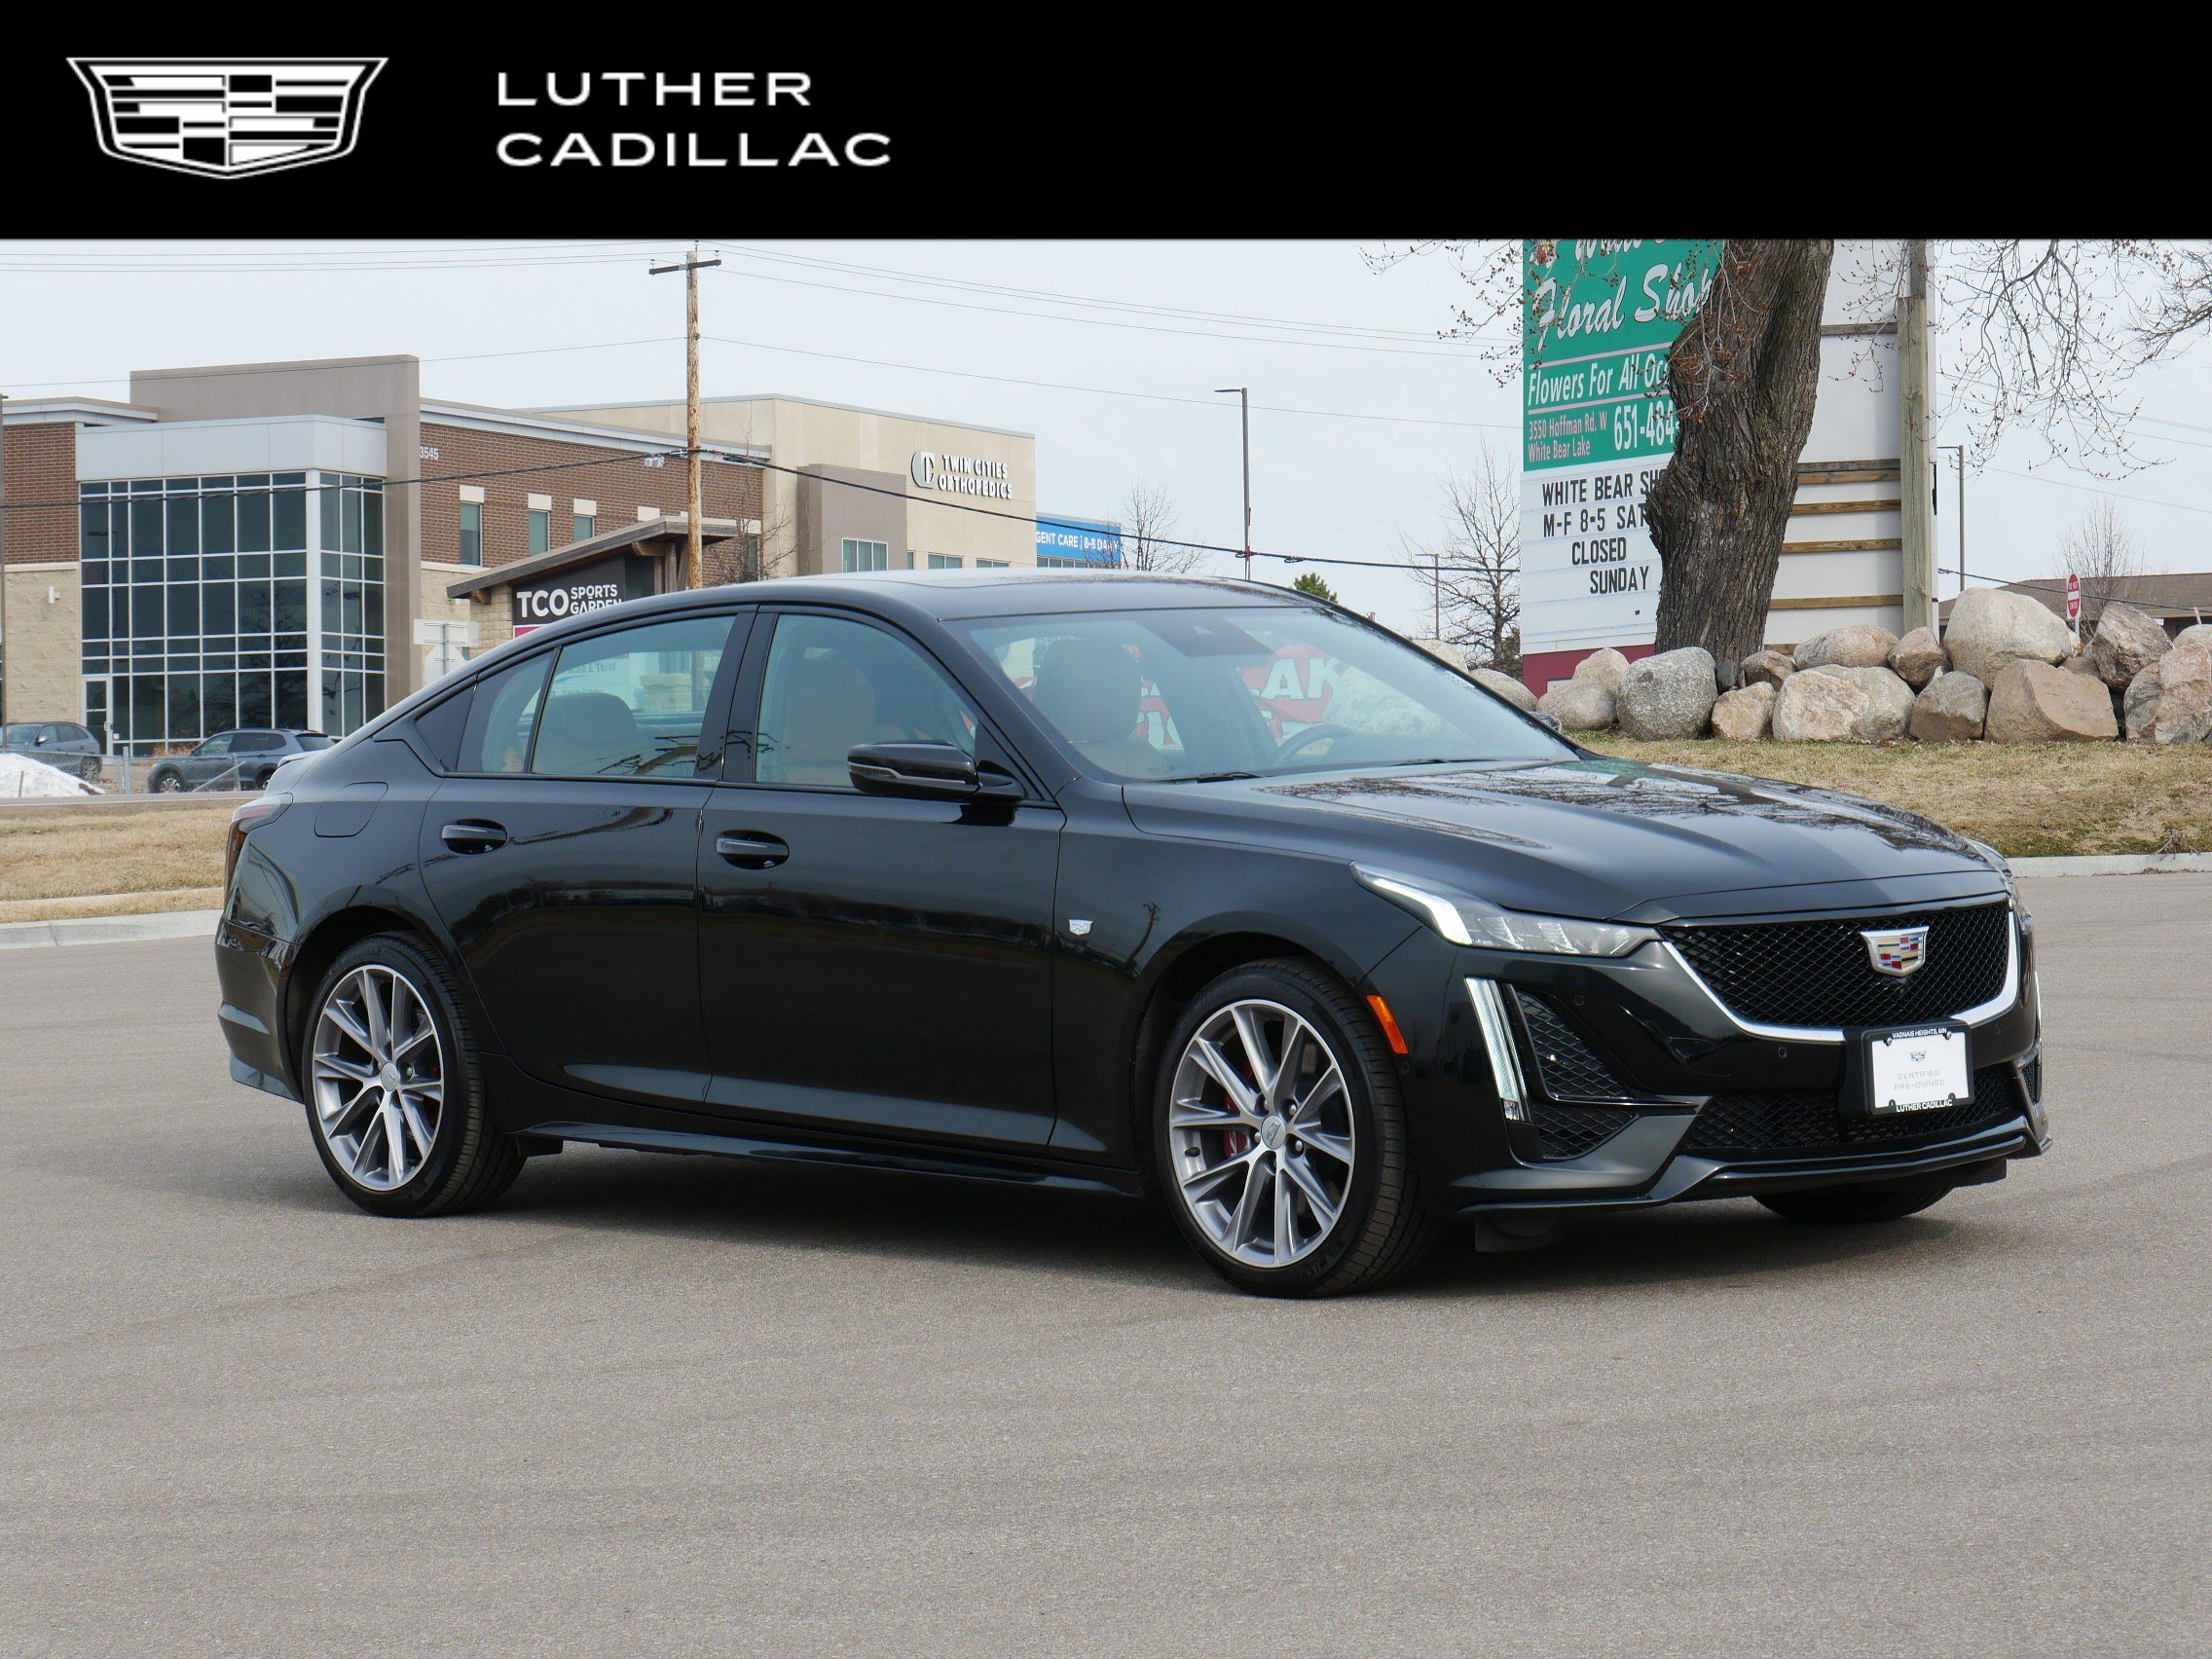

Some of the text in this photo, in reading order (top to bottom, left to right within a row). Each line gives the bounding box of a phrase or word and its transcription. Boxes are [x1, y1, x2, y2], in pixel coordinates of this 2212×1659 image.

[1531, 261, 1714, 351] Floral Shop
[1528, 369, 1585, 406] Flowers
[1589, 362, 1614, 397] For
[1618, 353, 1641, 391] All
[1529, 420, 1547, 440] 3550
[1549, 414, 1582, 438] Hoffman
[1585, 413, 1598, 432] Rd.
[1599, 409, 1607, 430] W
[420, 445, 439, 461] 3545
[1528, 434, 1591, 462] White Bear Lake
[941, 454, 1008, 479] TWIN CITIES
[938, 473, 1013, 499] ORTHOPEDICS
[1542, 478, 1587, 506] WHITE
[1595, 472, 1633, 501] BEAR
[1543, 511, 1571, 537] M-F
[1580, 507, 1605, 533] 8-5
[1057, 534, 1079, 548] CARE
[1571, 536, 1627, 566] CLOSED
[1590, 566, 1649, 595] SUNDAY
[516, 584, 618, 618] TCO SPORTS
[1894, 1079, 1945, 1090] PRE-OWNED
[1898, 1069, 1940, 1081] CERTIFIED
[1896, 1099, 1953, 1113] LUTHER CADILLAC
